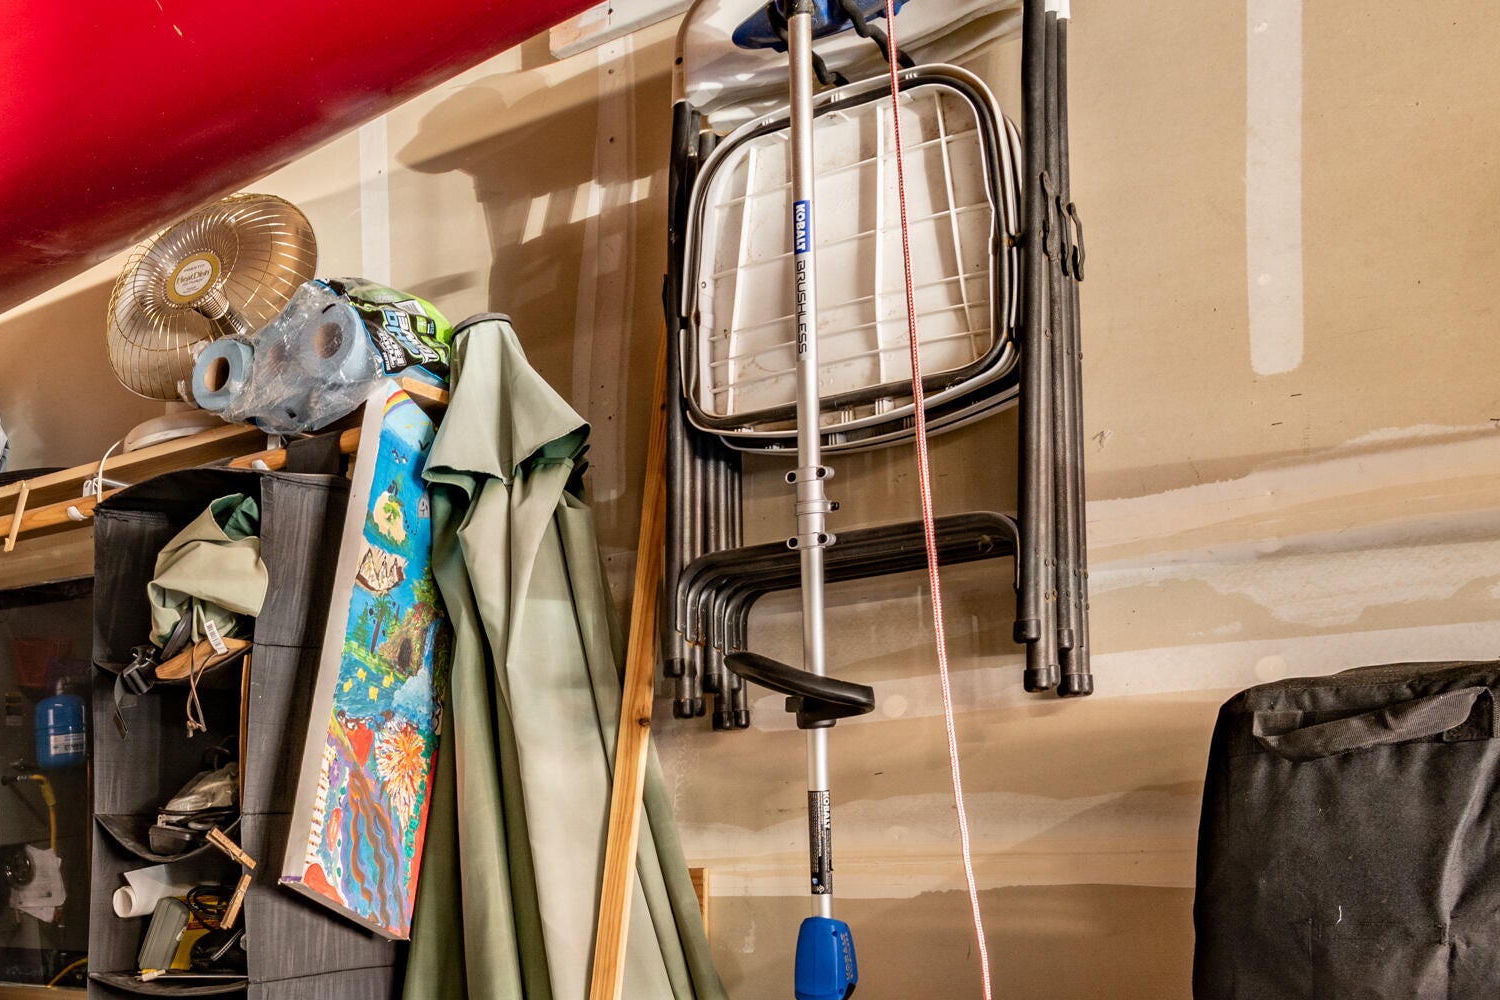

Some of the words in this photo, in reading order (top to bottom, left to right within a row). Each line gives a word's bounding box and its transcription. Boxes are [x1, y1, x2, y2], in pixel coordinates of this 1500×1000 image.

[795, 203, 806, 251] KOBALT
[796, 259, 807, 355] BRUSHLESS
[822, 791, 831, 830] KOBALT
